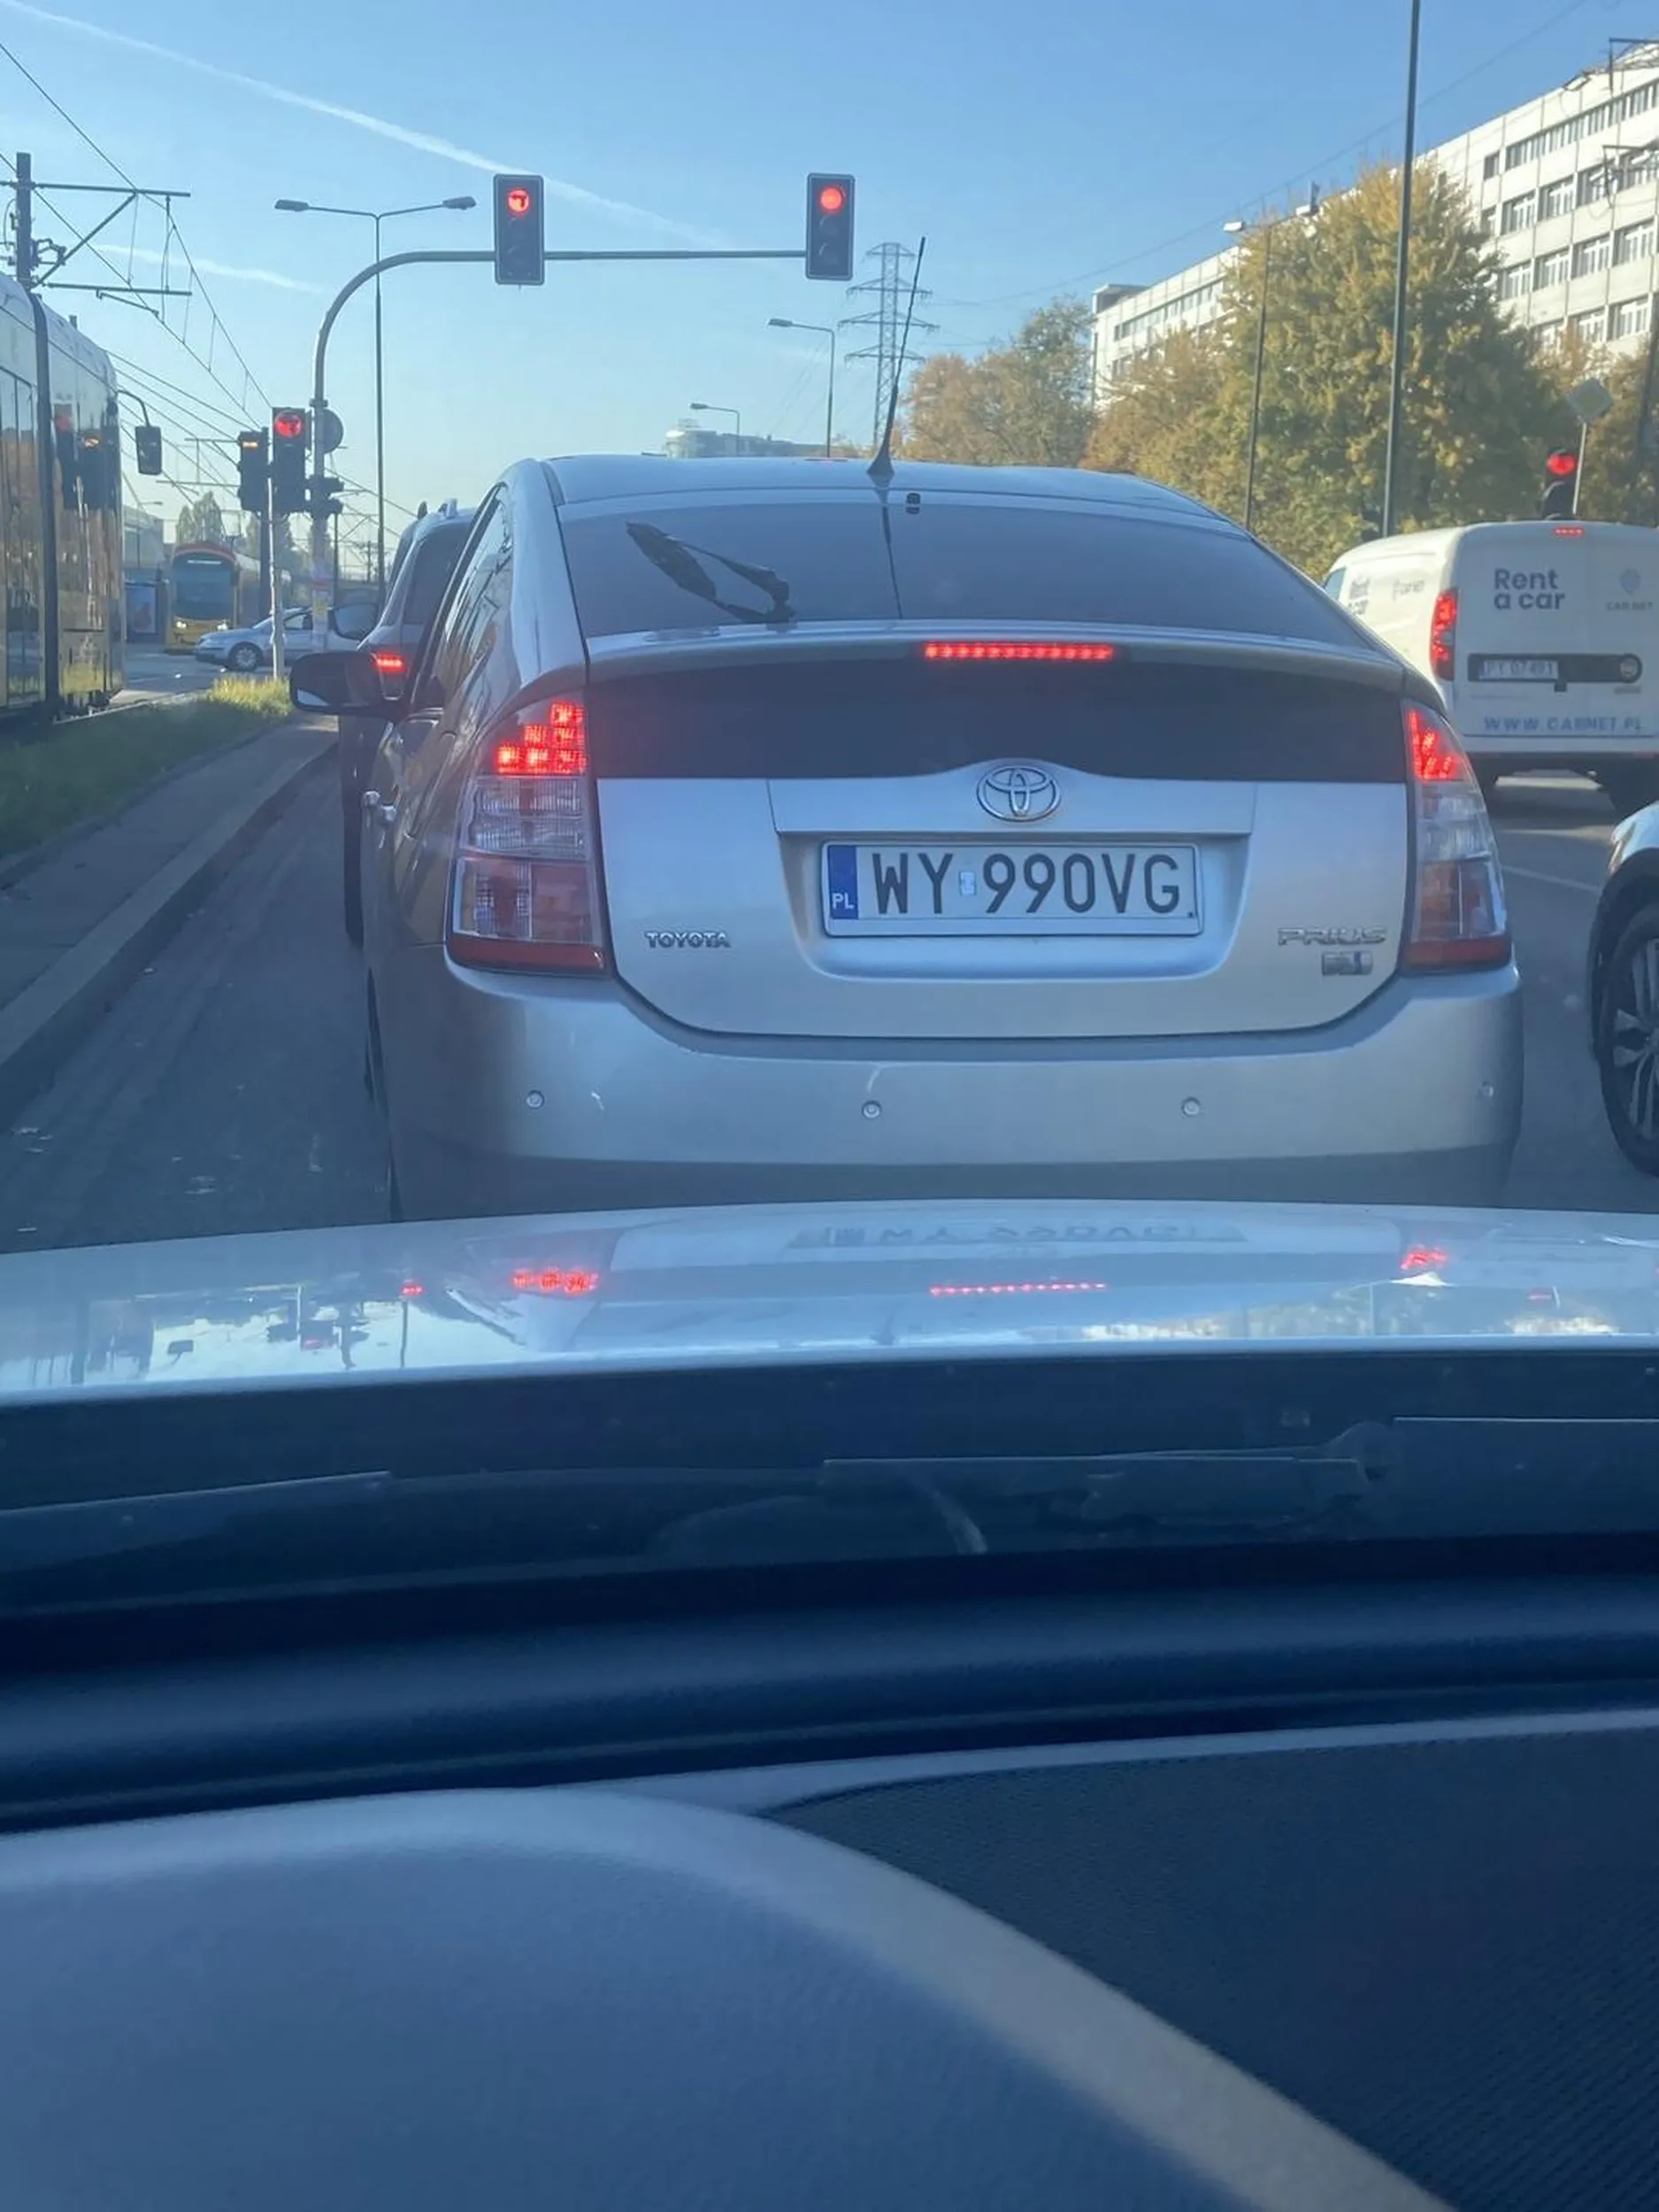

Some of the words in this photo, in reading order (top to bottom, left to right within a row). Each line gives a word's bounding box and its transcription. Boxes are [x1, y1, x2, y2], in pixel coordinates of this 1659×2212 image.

[1494, 568, 1558, 590] Rent
[1494, 593, 1511, 611] a
[1518, 592, 1565, 611] car
[872, 852, 954, 915] WY
[982, 852, 1180, 915] 990VG
[833, 893, 856, 910] PL
[644, 930, 732, 949] TOYOTA
[1278, 926, 1386, 947] PRIUS
